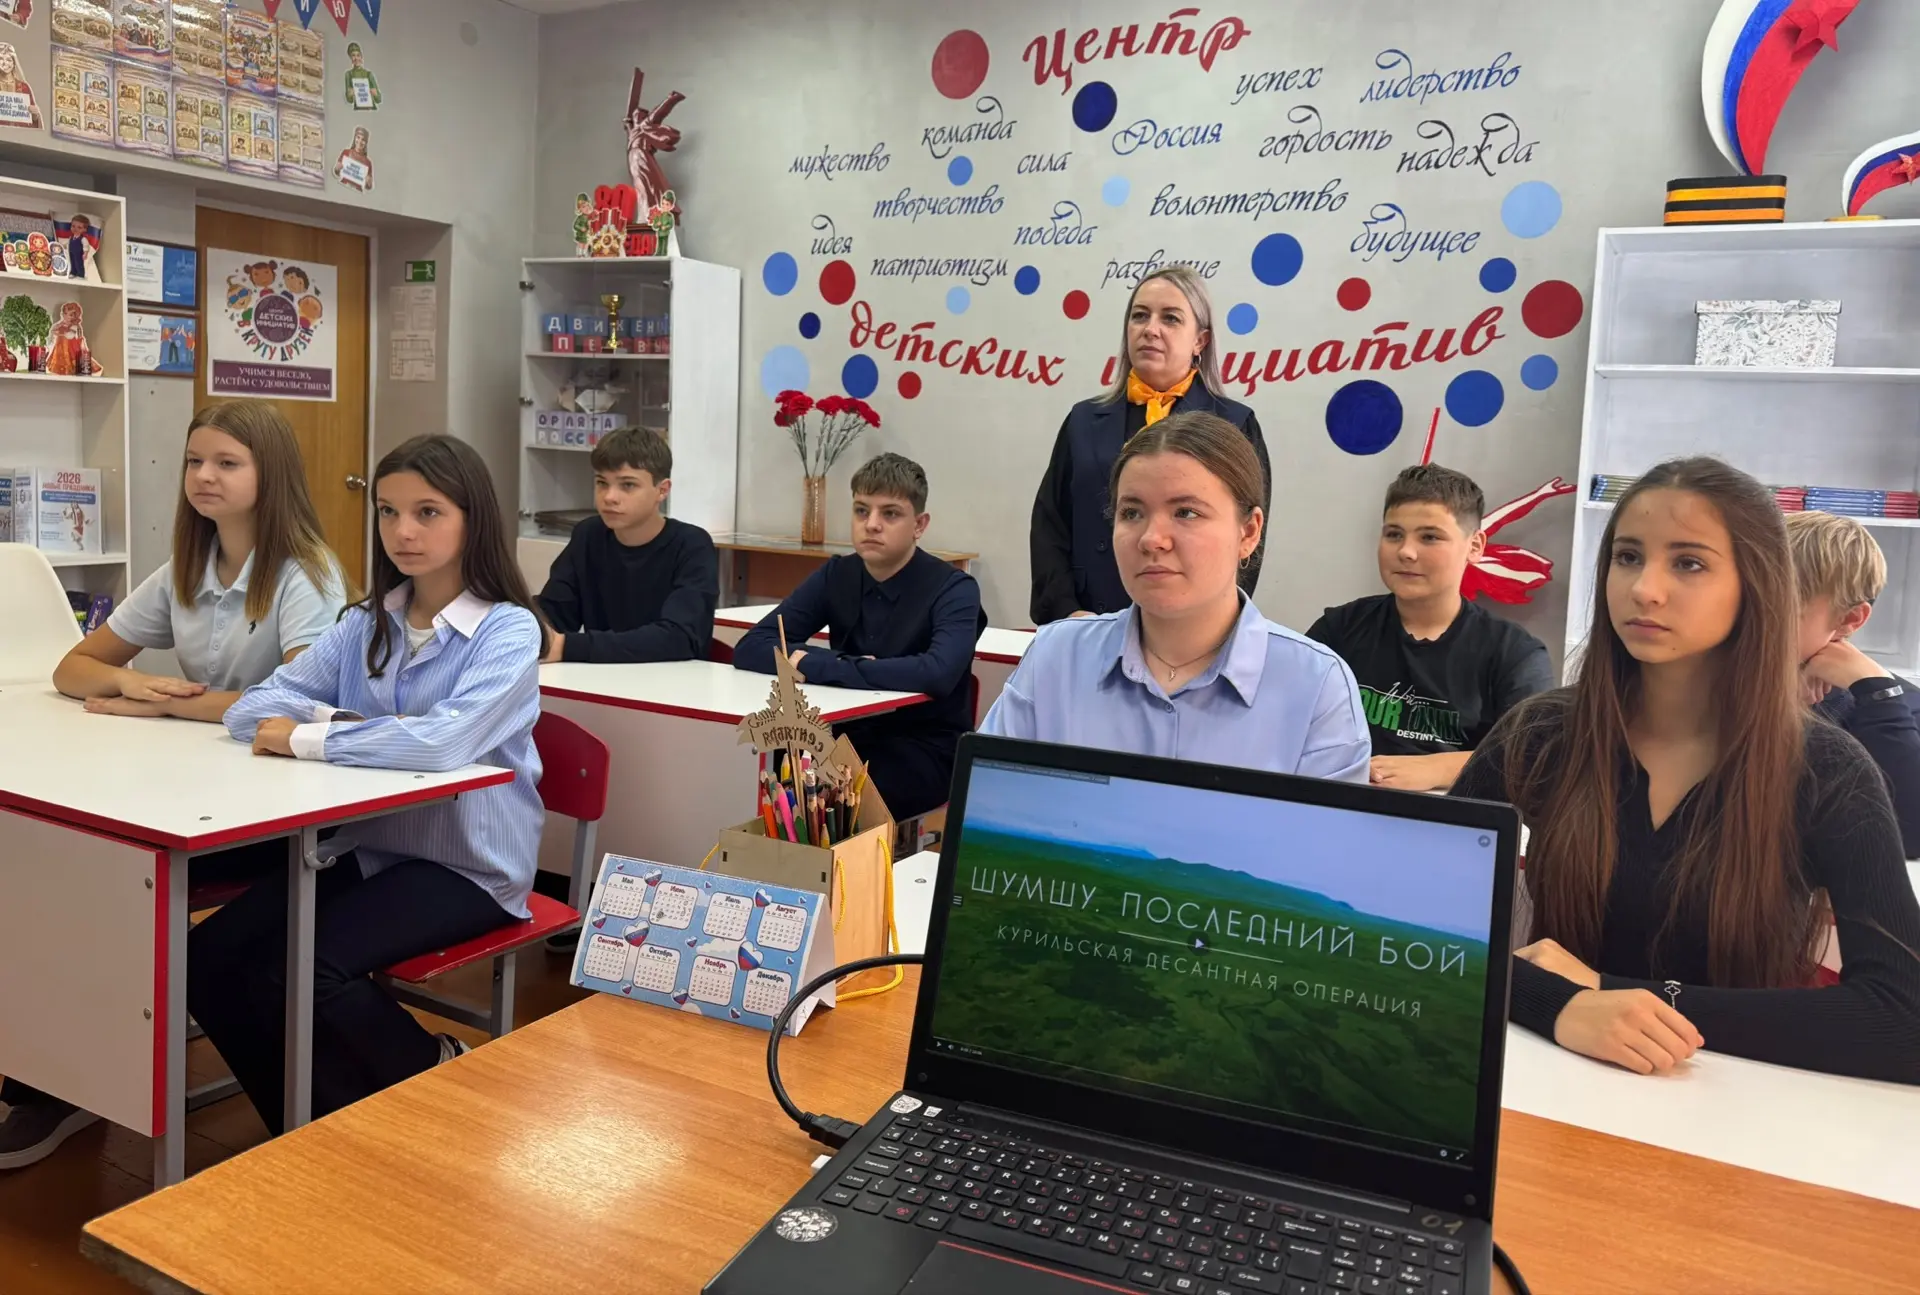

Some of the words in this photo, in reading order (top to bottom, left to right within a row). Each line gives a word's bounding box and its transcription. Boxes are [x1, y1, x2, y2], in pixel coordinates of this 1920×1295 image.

[1022, 8, 1251, 94] Центр
[1231, 66, 1323, 105] успех
[1360, 49, 1521, 106] лидерство
[922, 95, 1017, 159] команда
[1112, 117, 1222, 155] Россия
[1259, 105, 1392, 164] гордость
[1396, 112, 1540, 175] надежда
[789, 142, 891, 181] мужество
[1017, 151, 1072, 175] сила
[873, 184, 1004, 222] творчество
[1150, 177, 1349, 221] волонтерство
[811, 214, 853, 256] идея
[1014, 201, 1098, 246] победа
[1350, 203, 1481, 262] будущее
[870, 256, 1008, 286] патриотизм
[256, 320, 295, 329] ИНИЦИАТИВ
[259, 312, 293, 322] ДЕТСКИХ
[850, 301, 1065, 386] детских
[214, 375, 250, 386] РАСТЁМ
[251, 378, 258, 386] С
[259, 379, 330, 390] УДОВОЛЬСТВИЕМ
[239, 367, 276, 378] УЧИМСЯ
[277, 369, 311, 380] ВЕСЕЛО,
[538, 414, 612, 429] ОРЛЯТА
[57, 472, 81, 484] 2026
[1360, 688, 1403, 731] OUR
[1397, 729, 1435, 742] DESTINY
[621, 877, 634, 885] Май
[775, 905, 797, 914] Август
[971, 866, 1099, 912] ШУМШУ.
[1121, 891, 1354, 958] ПОСЛЕДНИЙ
[1380, 935, 1466, 977] БОЙ
[597, 936, 624, 948] Сентябрь
[648, 947, 673, 957] Октябрь
[704, 958, 727, 969] Ноябрь
[756, 971, 784, 983] Декабрь
[998, 925, 1134, 963] КУРИЛЬСКАЯ
[1146, 952, 1278, 991] ДЕСАНТНАЯ
[1293, 980, 1422, 1018] ОПЕРАЦИЯ
